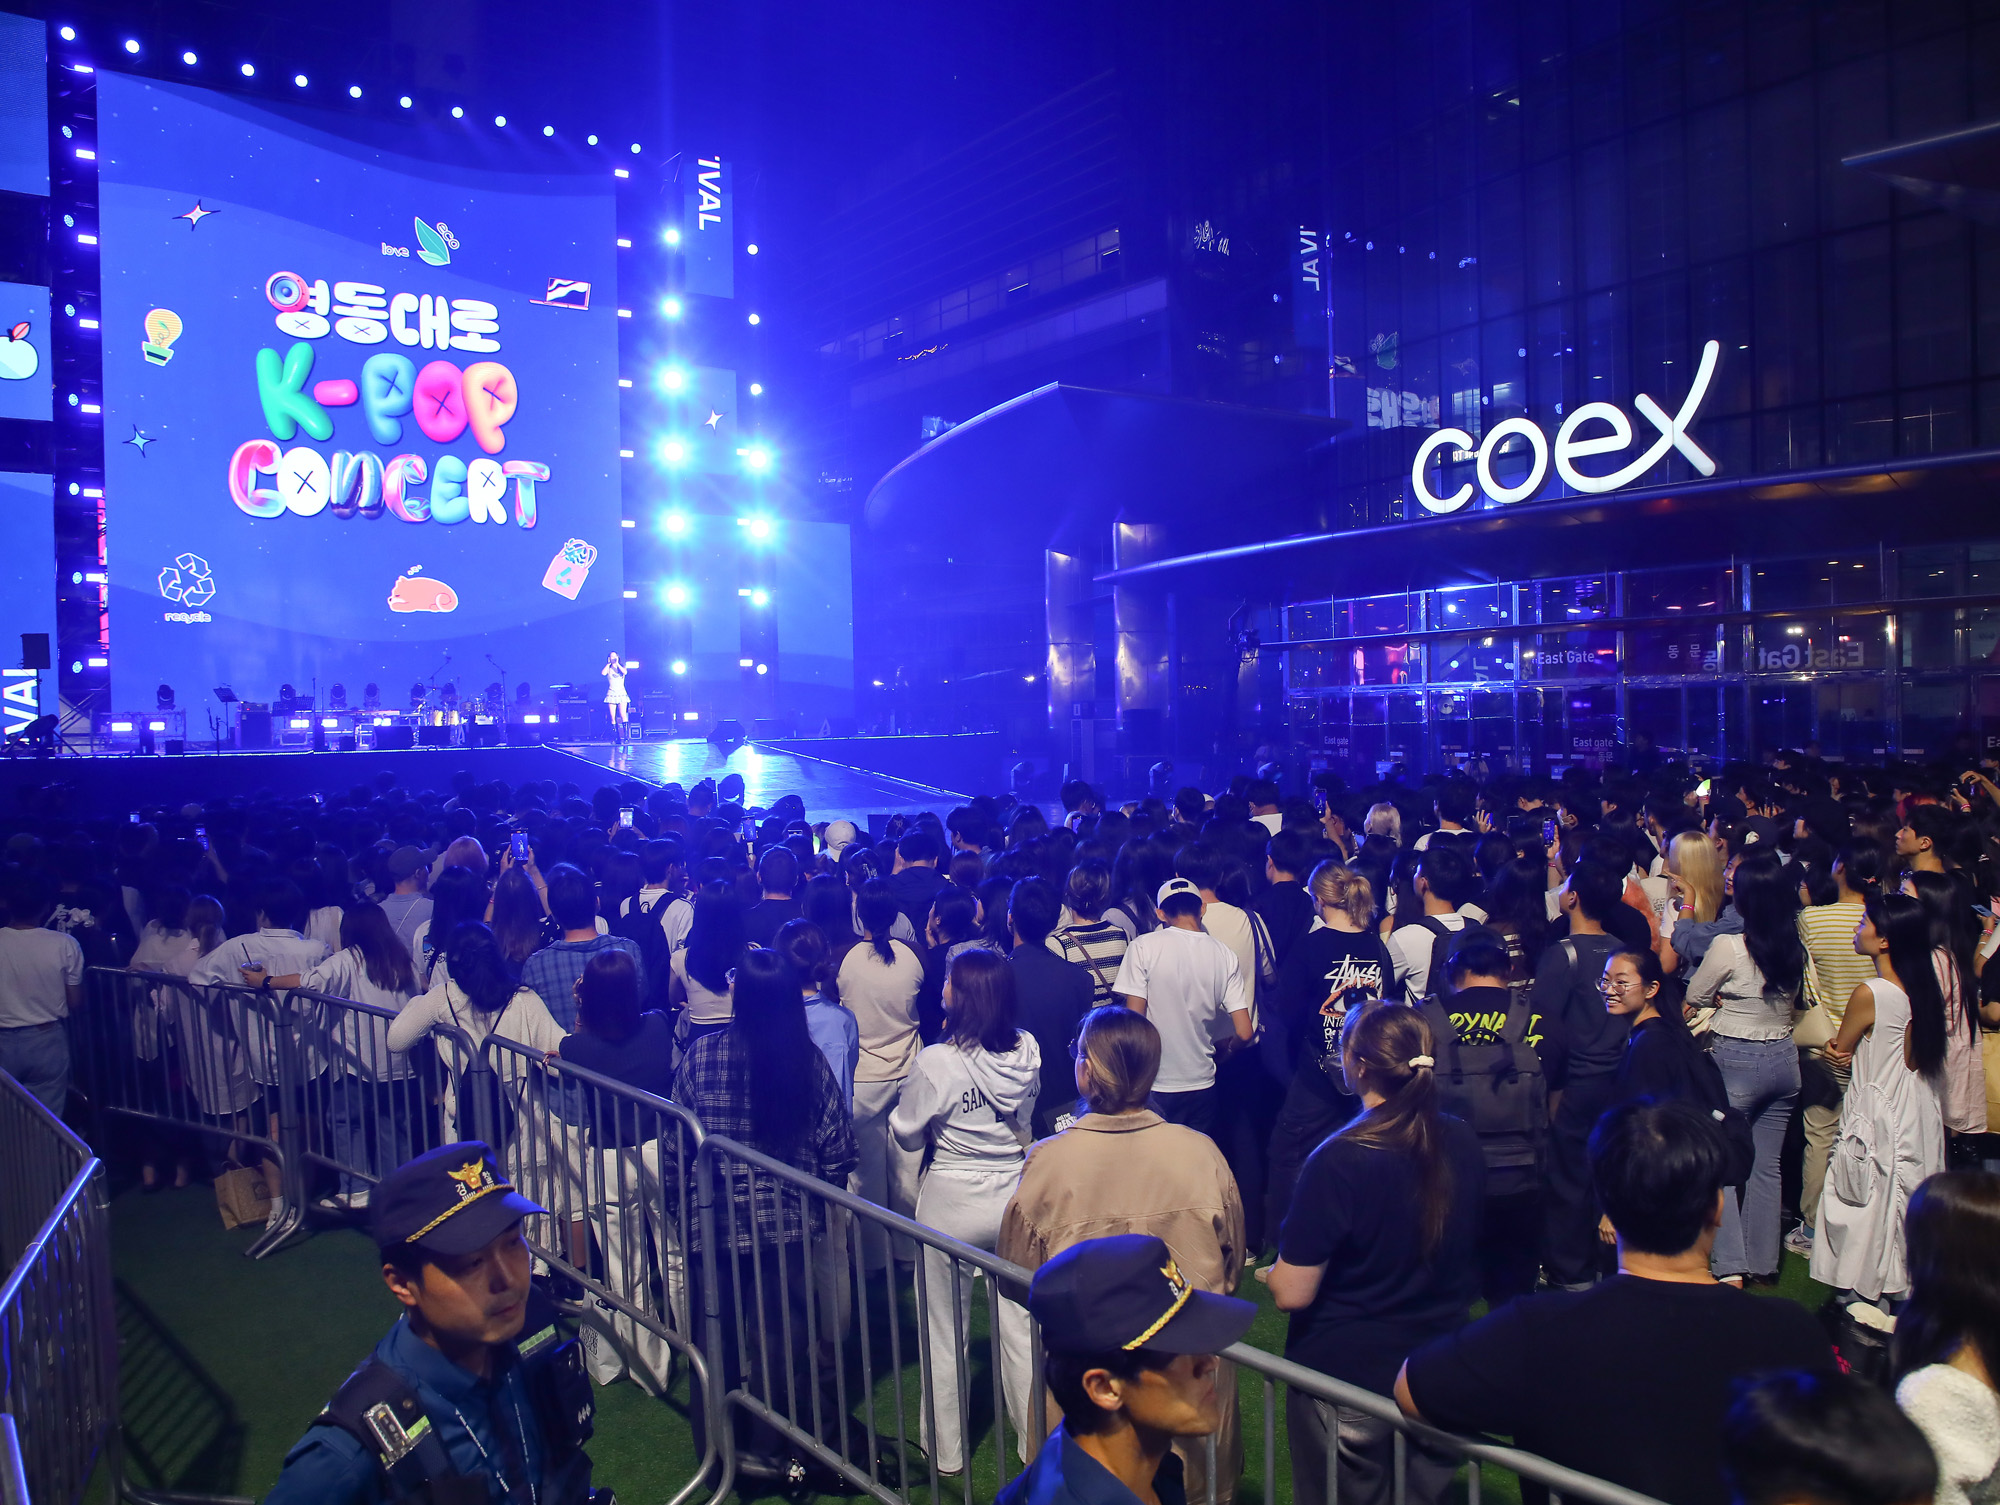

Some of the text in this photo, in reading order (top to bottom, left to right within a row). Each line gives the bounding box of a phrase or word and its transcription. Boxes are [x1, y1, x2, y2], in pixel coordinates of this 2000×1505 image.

[698, 156, 721, 231] IVAL
[382, 242, 410, 257] love
[437, 222, 460, 250] eco
[265, 271, 501, 353] 영동대로
[256, 342, 518, 454] K-POP
[1412, 340, 1719, 514] coex
[164, 611, 212, 624] recycle
[1537, 650, 1595, 665] East Gate
[1573, 737, 1614, 749] East gate
